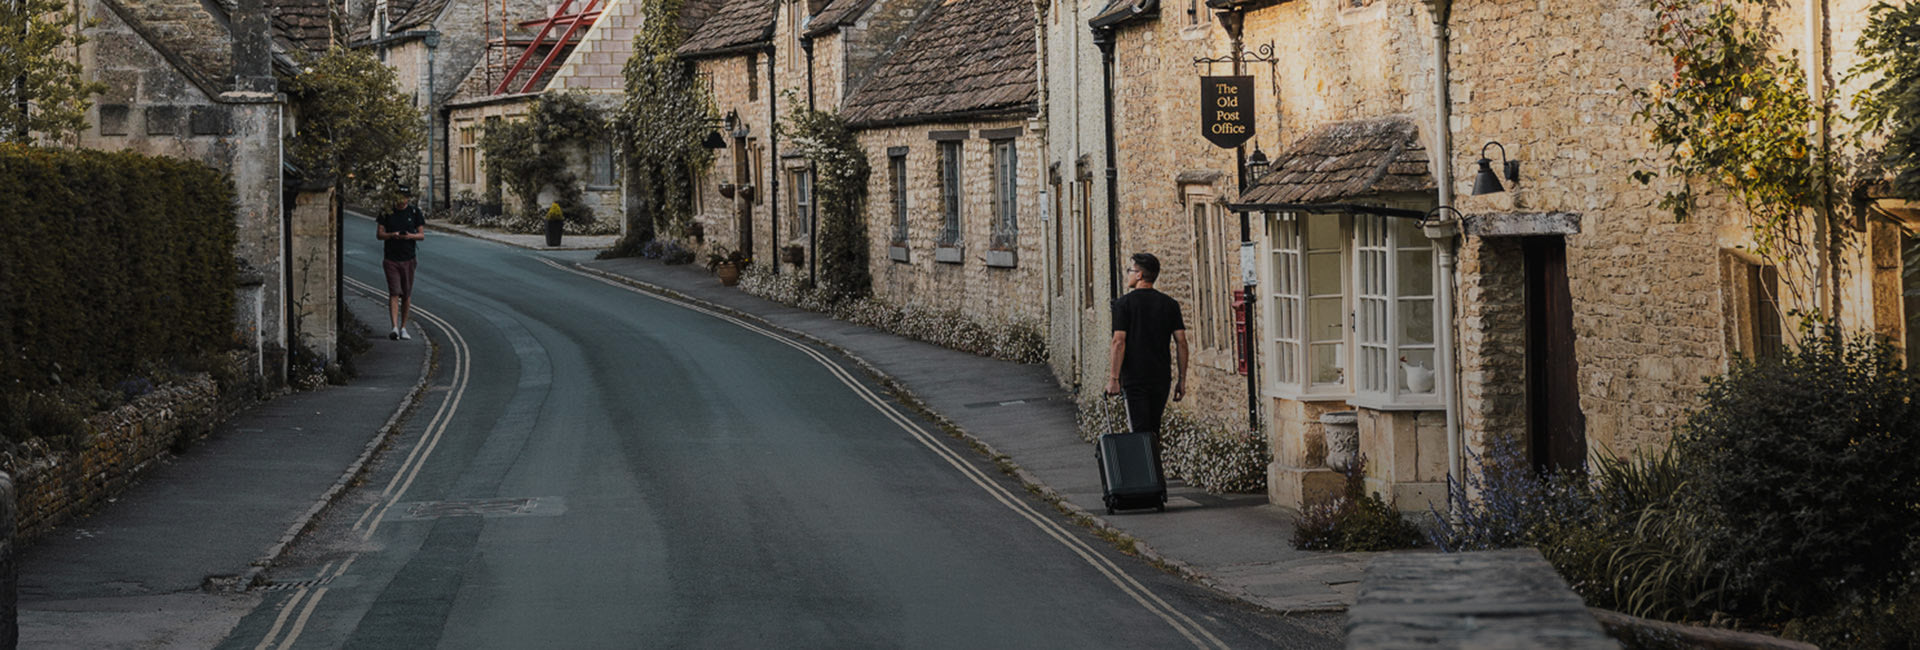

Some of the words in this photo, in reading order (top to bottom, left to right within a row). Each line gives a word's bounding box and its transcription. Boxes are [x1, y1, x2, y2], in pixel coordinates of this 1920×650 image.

[1216, 83, 1238, 94] The
[1217, 96, 1238, 107] Old
[1216, 110, 1239, 121] Post
[1211, 122, 1245, 134] Office
